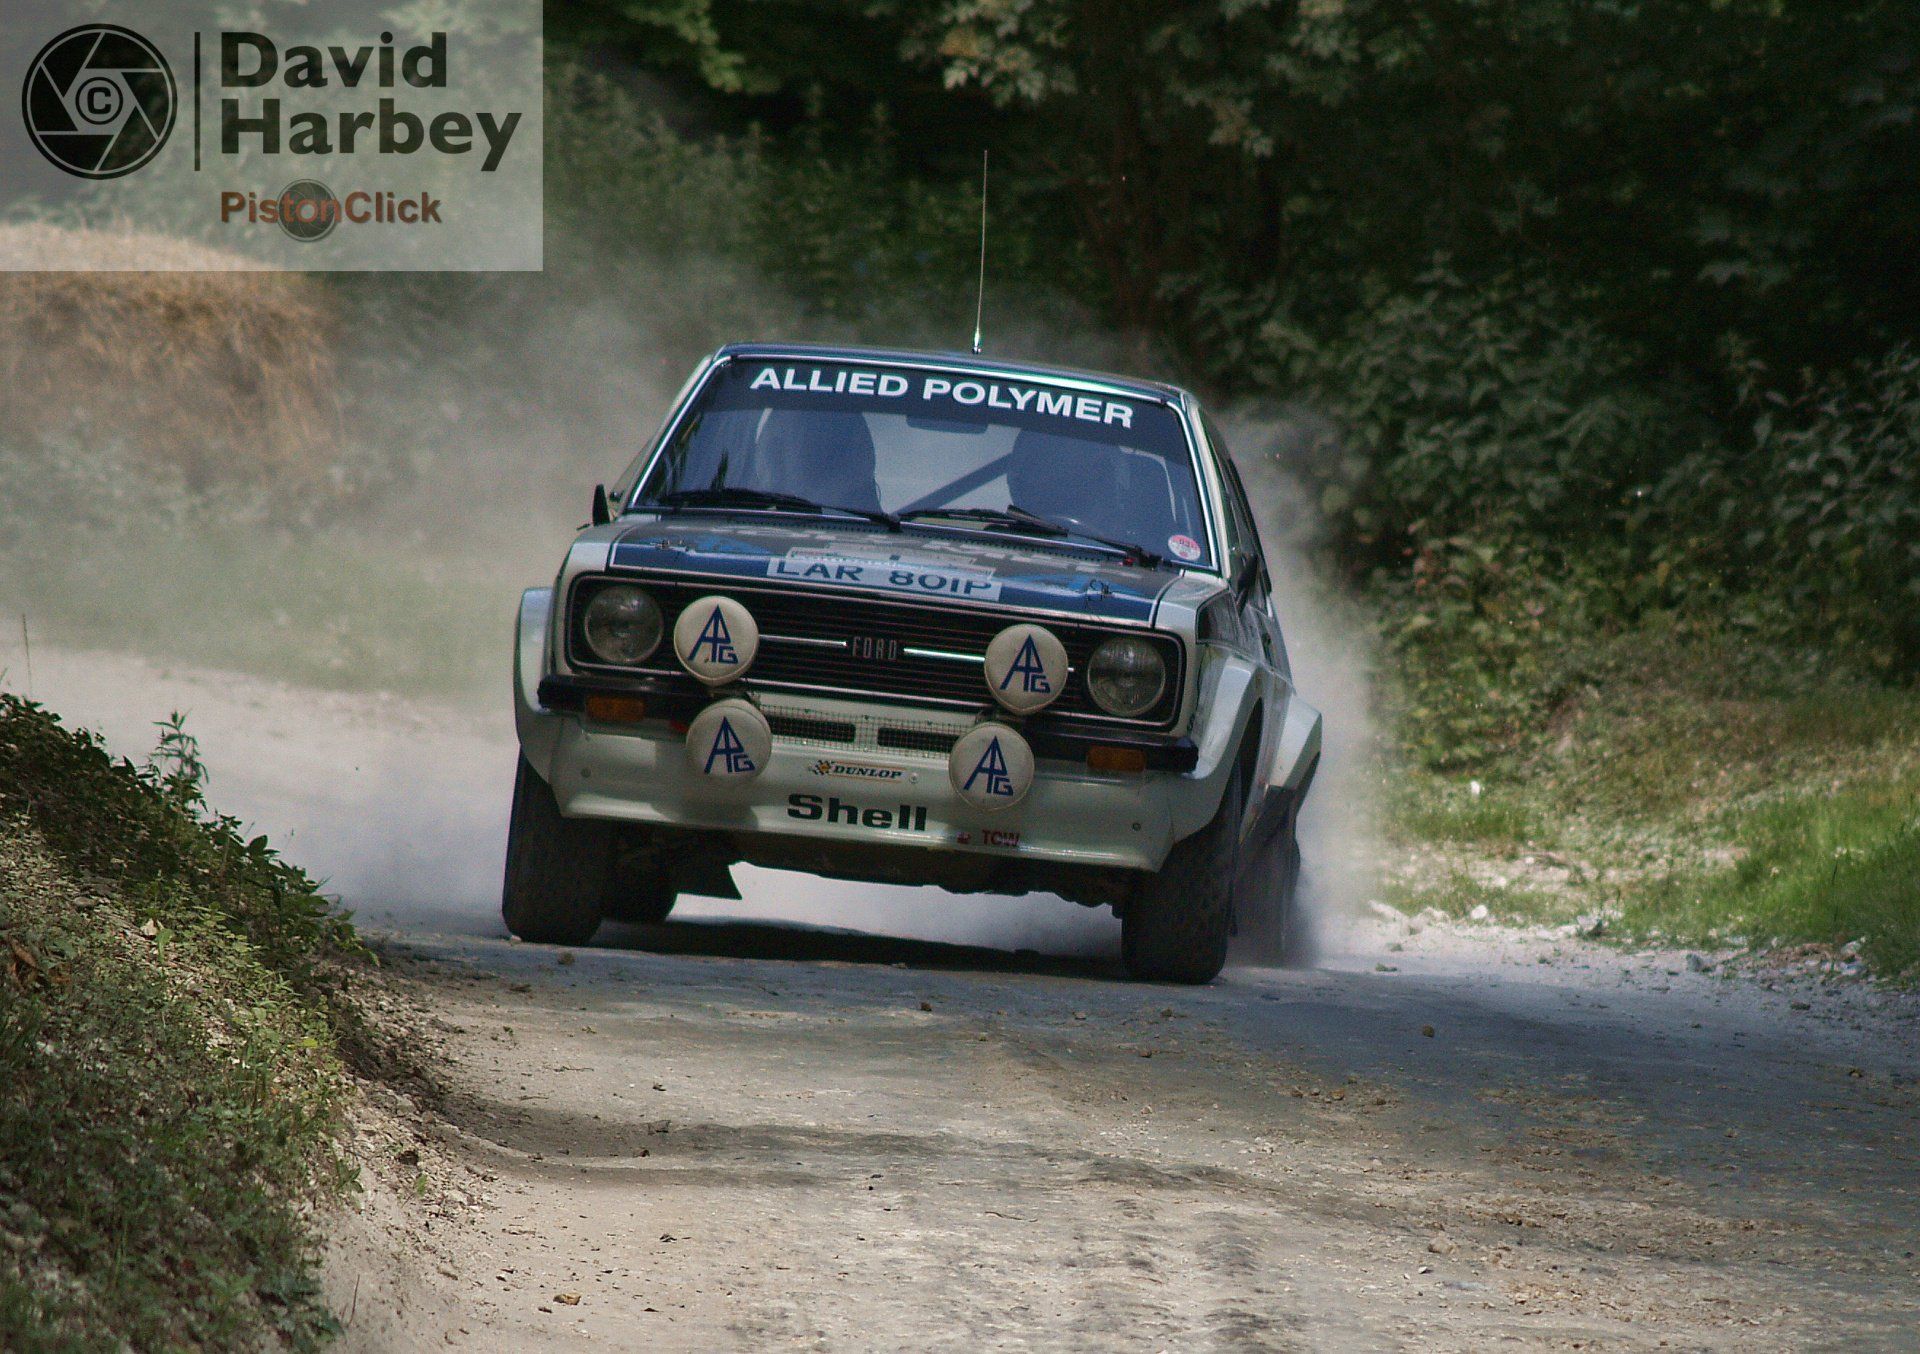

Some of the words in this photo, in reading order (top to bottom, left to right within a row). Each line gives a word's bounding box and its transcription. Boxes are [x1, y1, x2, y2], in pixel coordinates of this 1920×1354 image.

[750, 367, 909, 398] ALLIED
[922, 377, 1135, 429] POLYMER
[776, 560, 864, 581] LAR
[832, 764, 903, 779] DUNLOP
[787, 793, 928, 832] Shell
